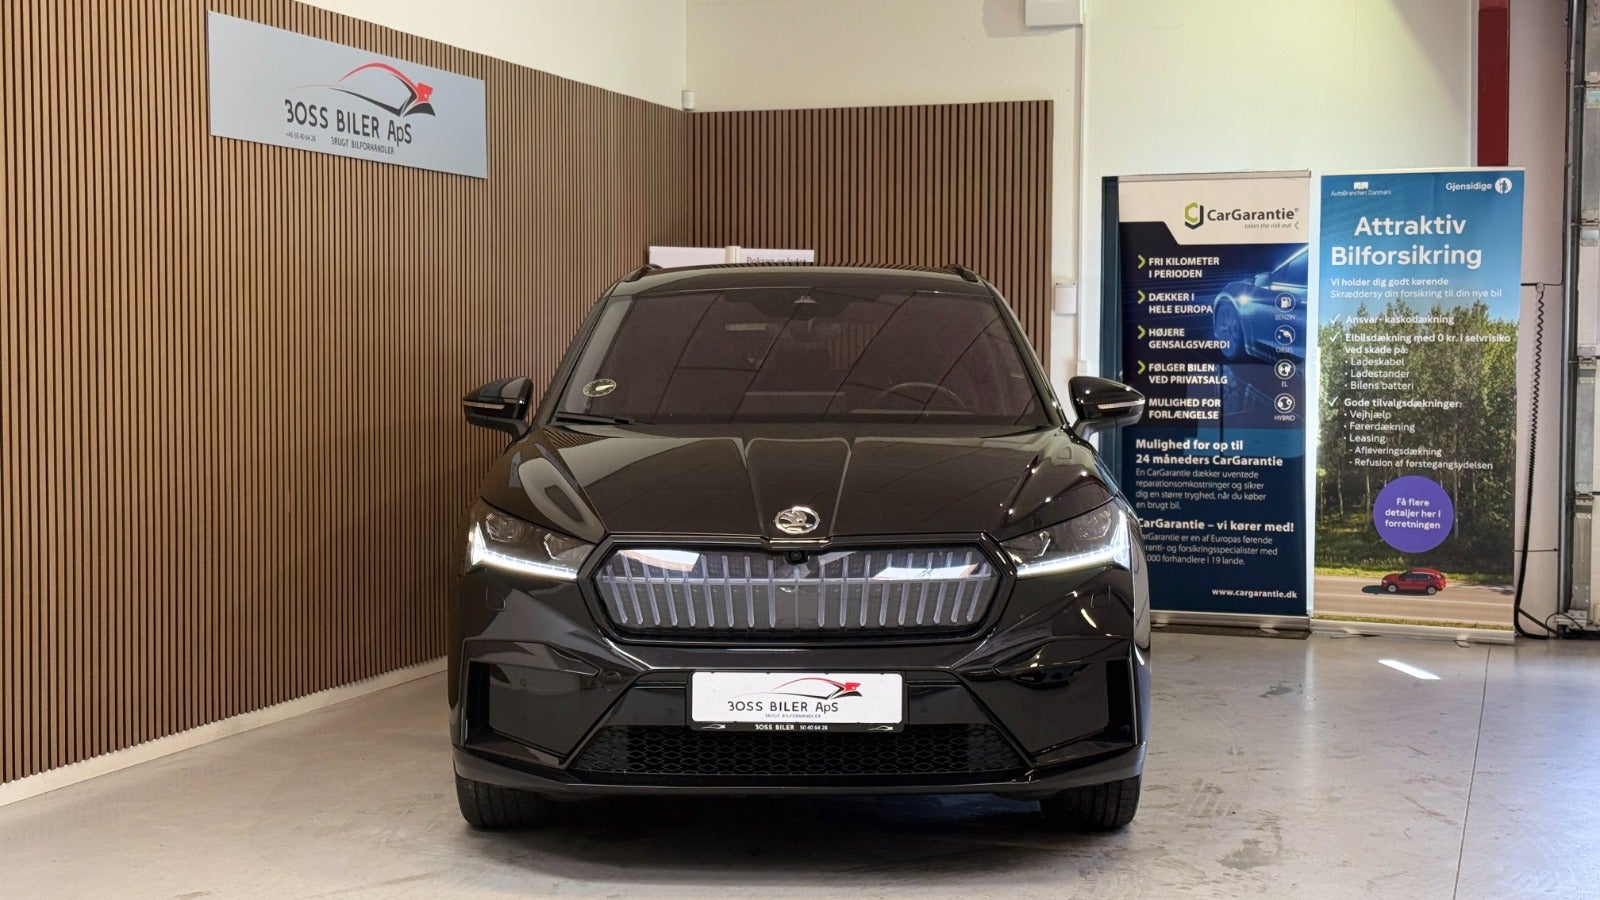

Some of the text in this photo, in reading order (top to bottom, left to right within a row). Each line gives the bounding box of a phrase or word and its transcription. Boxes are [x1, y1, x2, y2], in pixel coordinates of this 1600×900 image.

[336, 109, 380, 139] BILER
[387, 119, 412, 147] ApS
[350, 140, 395, 155] BILFORHANDLER
[1445, 182, 1492, 192] Gjensidige
[1354, 214, 1467, 236] Attraktiv
[1149, 257, 1220, 266] FRI KILOMETER
[1331, 244, 1482, 270] Bilforsikring
[1149, 269, 1203, 278] I PERIODEN
[1330, 277, 1449, 288] Vi holder dig godt kørende
[1149, 292, 1195, 302] DÆKKER I
[1330, 289, 1502, 299] Skræddersy din forsikring til din nye bil
[1149, 305, 1213, 314] HELE EUROPA
[1385, 315, 1455, 325] kaskodækning
[1149, 327, 1185, 337] HØJERE
[1345, 333, 1511, 344] Elbilsdækning med 0 kr. i selvrisiko
[1149, 340, 1230, 350] GENSALGSVÆRDI
[1345, 345, 1409, 356] ved skade på:
[1350, 357, 1405, 366] Ladeskabel
[1149, 363, 1215, 373] FØLGER BILEN
[1350, 369, 1410, 378] Ladestander
[1149, 375, 1228, 385] VED PRIVATSALG
[1281, 380, 1288, 388] EL
[1350, 381, 1414, 390] Bilens batteri
[1149, 398, 1221, 408] MULIGHED FOR
[1344, 398, 1463, 409] Gode tilvalgsdækninger:
[1149, 410, 1219, 420] FORLÆNGELSE
[1350, 411, 1391, 421] Vejhjælp
[1350, 422, 1416, 433] Førerdækning
[1135, 438, 1244, 452] Mulighed for op til
[1354, 446, 1442, 457] Afleveringsdækning
[1135, 453, 1284, 467] 24 måneders CarGarantie
[1354, 458, 1493, 471] Refusion af førstegangsydelsen
[1135, 468, 1259, 479] En CarGarantie dækker uventede
[1135, 480, 1265, 490] reparationsomkostninger og sikrer
[1135, 490, 1148, 499] dig
[1161, 490, 1183, 499] større
[1184, 490, 1216, 501] tryghed,
[1217, 491, 1230, 500] når
[1231, 491, 1242, 500] du
[1243, 492, 1266, 501] køber
[1147, 500, 1168, 510] brugt
[1169, 501, 1181, 510] bil.
[1396, 497, 1430, 507] Få flere
[1384, 508, 1441, 519] detaljer her i
[1216, 519, 1228, 530] vi
[1230, 520, 1261, 531] kører
[1264, 521, 1294, 532] med!
[1384, 519, 1441, 530] forretningen
[1142, 533, 1179, 541] arGarantie
[1202, 533, 1210, 542] af
[1210, 534, 1241, 544] Europas
[1242, 535, 1273, 545] førende
[1166, 546, 1177, 554] og
[1178, 544, 1258, 555] forsikringsspecialister
[1260, 546, 1278, 555] med
[1162, 554, 1206, 564] forhandlere
[1211, 556, 1221, 565] 19
[1222, 556, 1246, 565] lande.
[1211, 588, 1298, 600] www.cargarantie.dk
[770, 701, 808, 712] BILER
[815, 702, 839, 714] ApS
